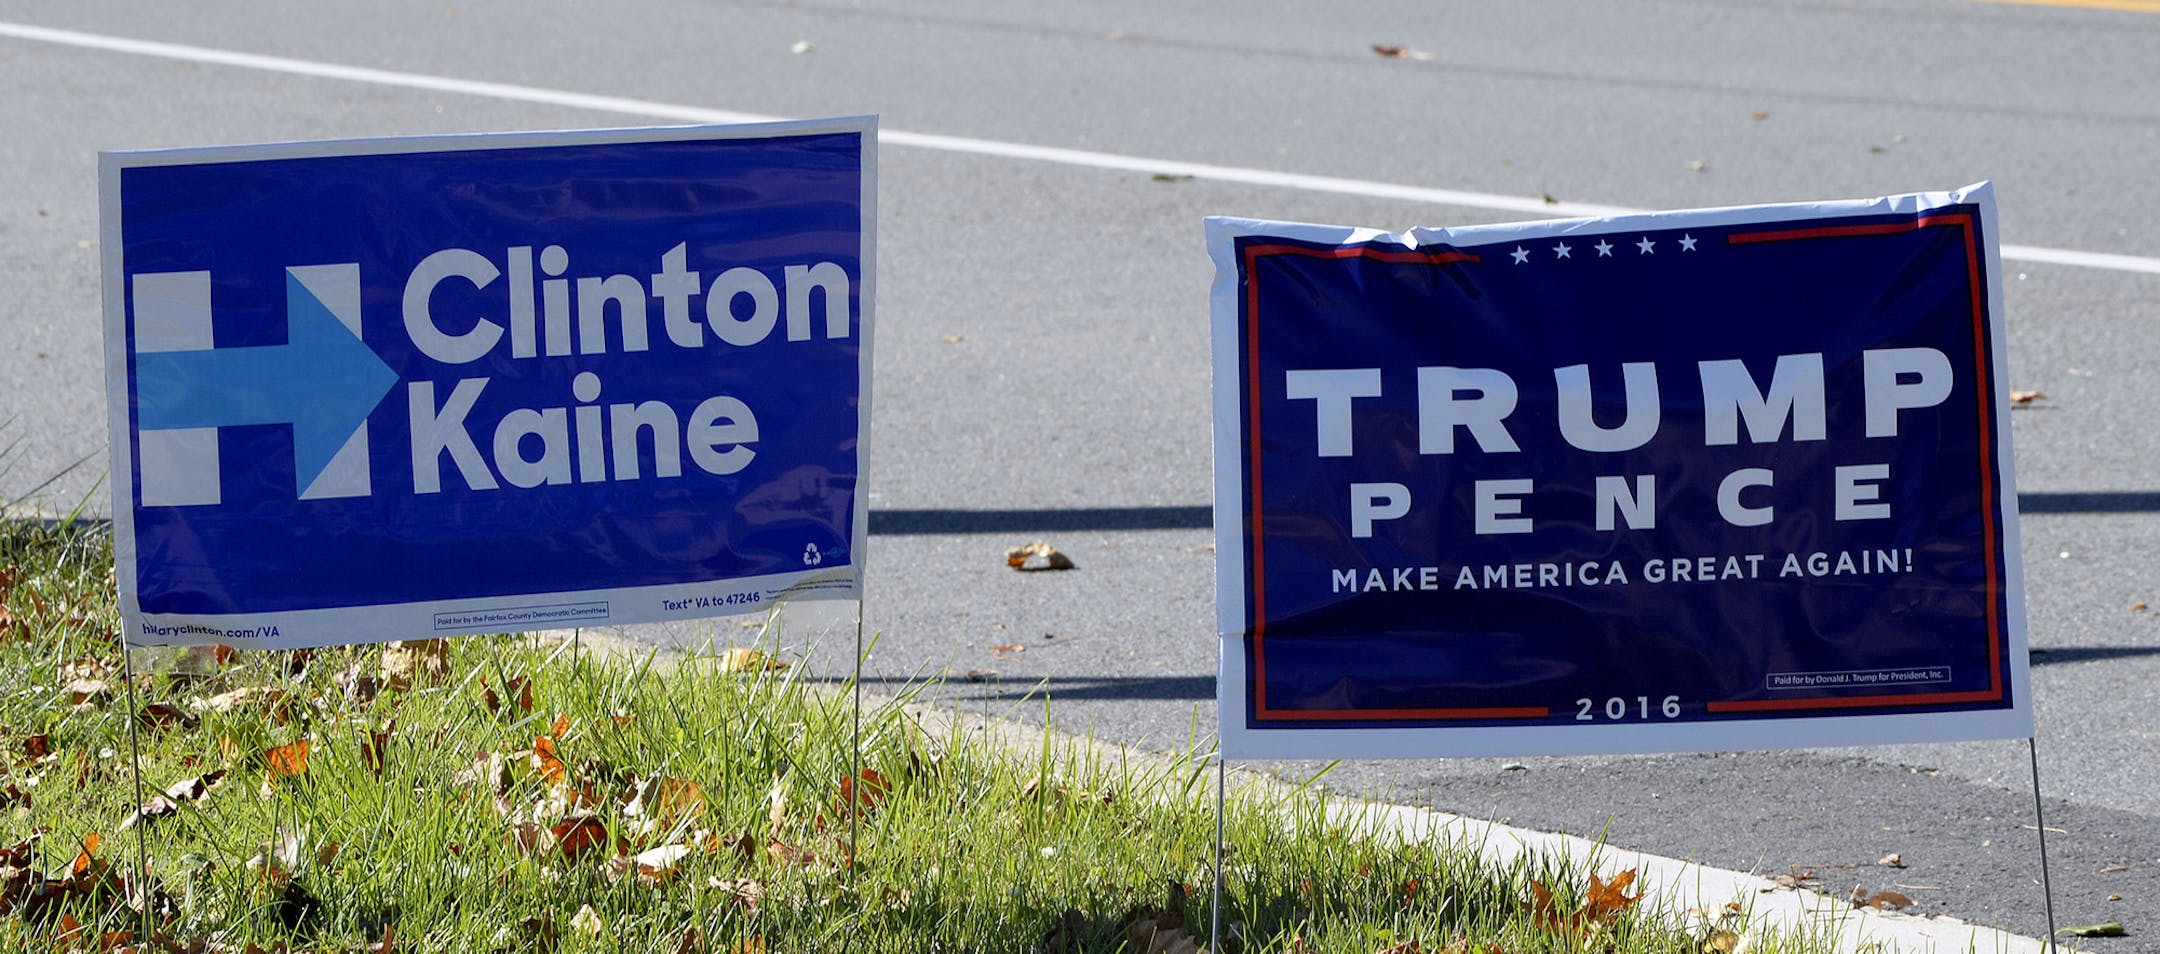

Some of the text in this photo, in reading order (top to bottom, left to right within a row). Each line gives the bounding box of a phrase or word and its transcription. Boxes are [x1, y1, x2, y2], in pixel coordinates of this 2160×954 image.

[401, 240, 852, 365] Clinton
[1286, 346, 1954, 459] TRUMP
[408, 371, 760, 496] Kaine
[1350, 463, 1892, 538] PENCE
[1332, 548, 1913, 593] MAKE AMERICA GREAT AGAIN!
[437, 607, 607, 625] Paid for by the Fairfax County Democratic Committee
[695, 597, 710, 608] VA
[712, 596, 724, 607] to
[726, 591, 760, 605] 47246
[142, 623, 280, 639] hilaryclinton.com/VA
[1774, 675, 1792, 685] Paid
[1792, 675, 1804, 684] for
[1805, 675, 1815, 685] by
[1815, 673, 1844, 684] Donald
[1852, 672, 1878, 683] Trump
[1878, 672, 1890, 682] for
[1890, 670, 1929, 681] President,
[1929, 670, 1944, 679] Inc.
[1575, 694, 1681, 721] 2016
